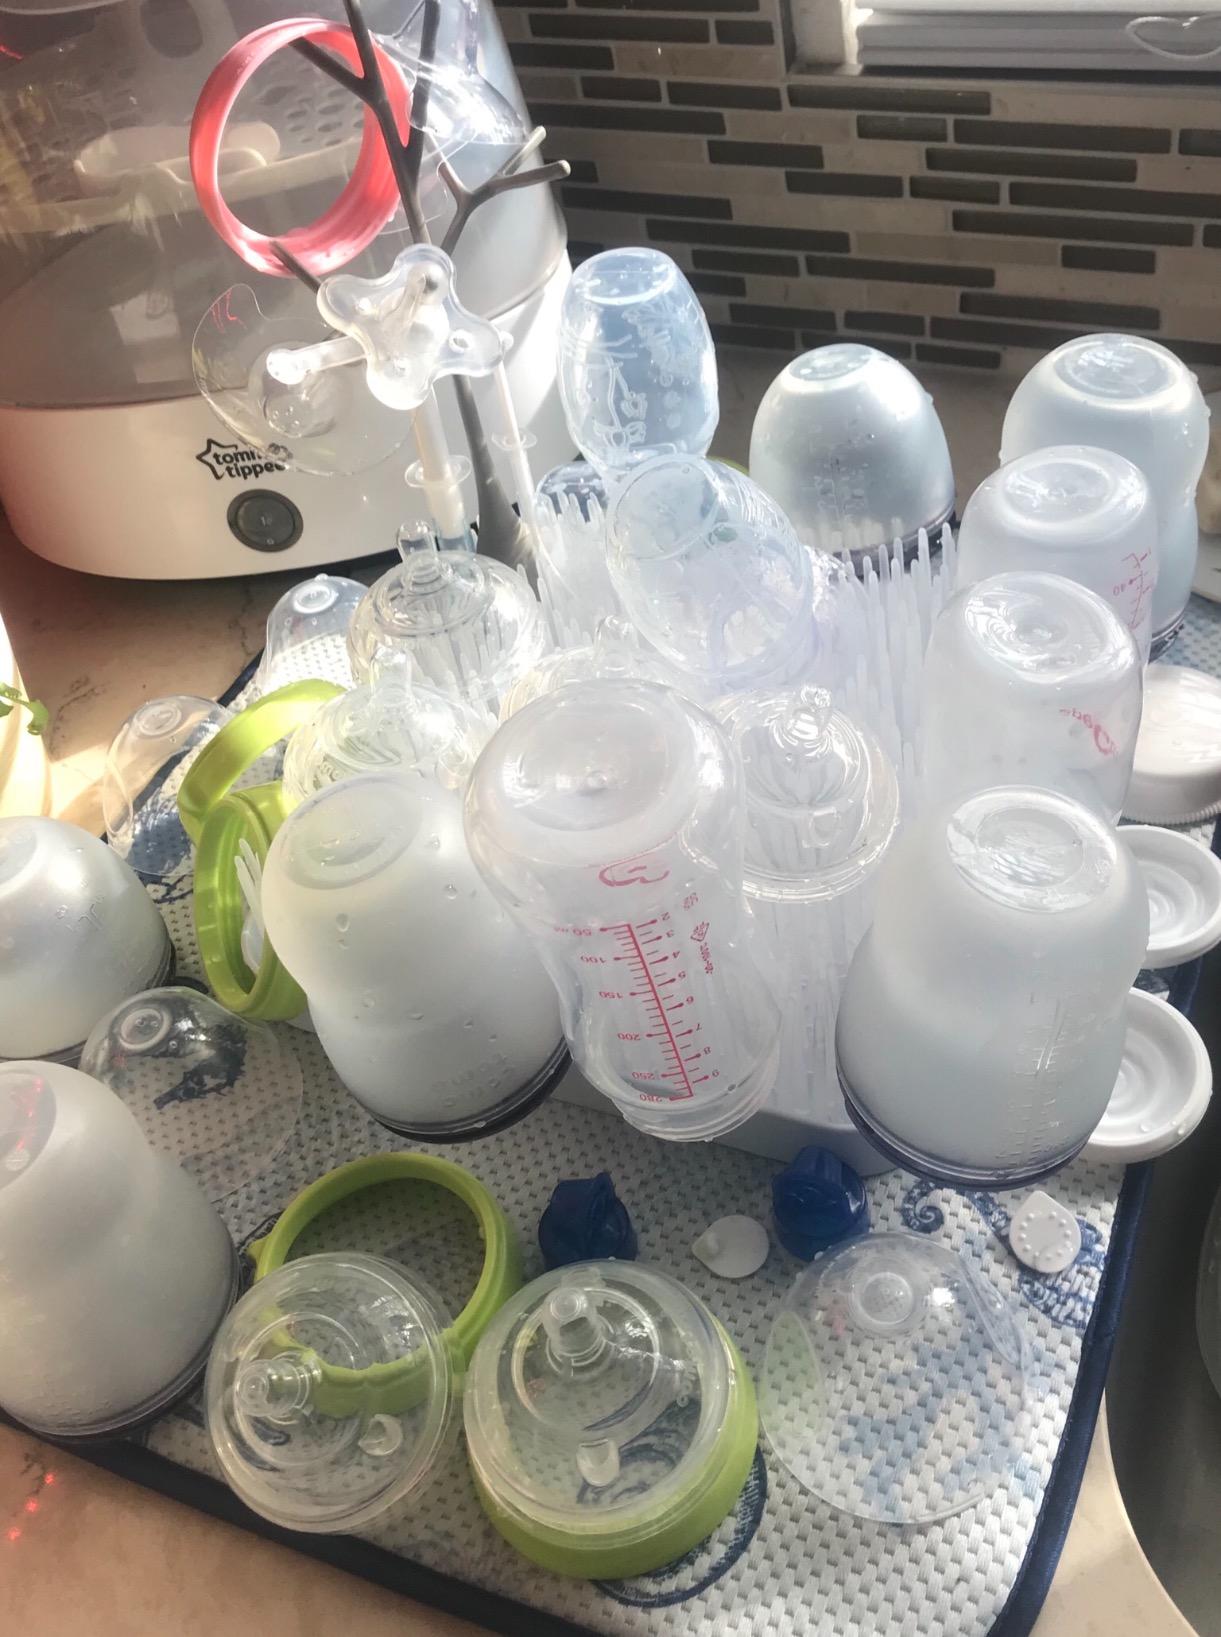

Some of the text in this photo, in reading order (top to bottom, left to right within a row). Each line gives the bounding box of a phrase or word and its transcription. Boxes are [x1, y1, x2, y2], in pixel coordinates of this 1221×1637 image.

[661, 912, 671, 921] 2
[573, 928, 592, 936] 50
[672, 950, 681, 959] 4
[580, 956, 606, 964] 100
[678, 970, 687, 979] 5
[598, 991, 624, 999] 150
[686, 995, 694, 1005] 6
[695, 1022, 703, 1032] 7
[617, 1032, 641, 1041] 200
[703, 1046, 712, 1056] 8
[631, 1071, 655, 1079] 250
[640, 1093, 663, 1102] 280
